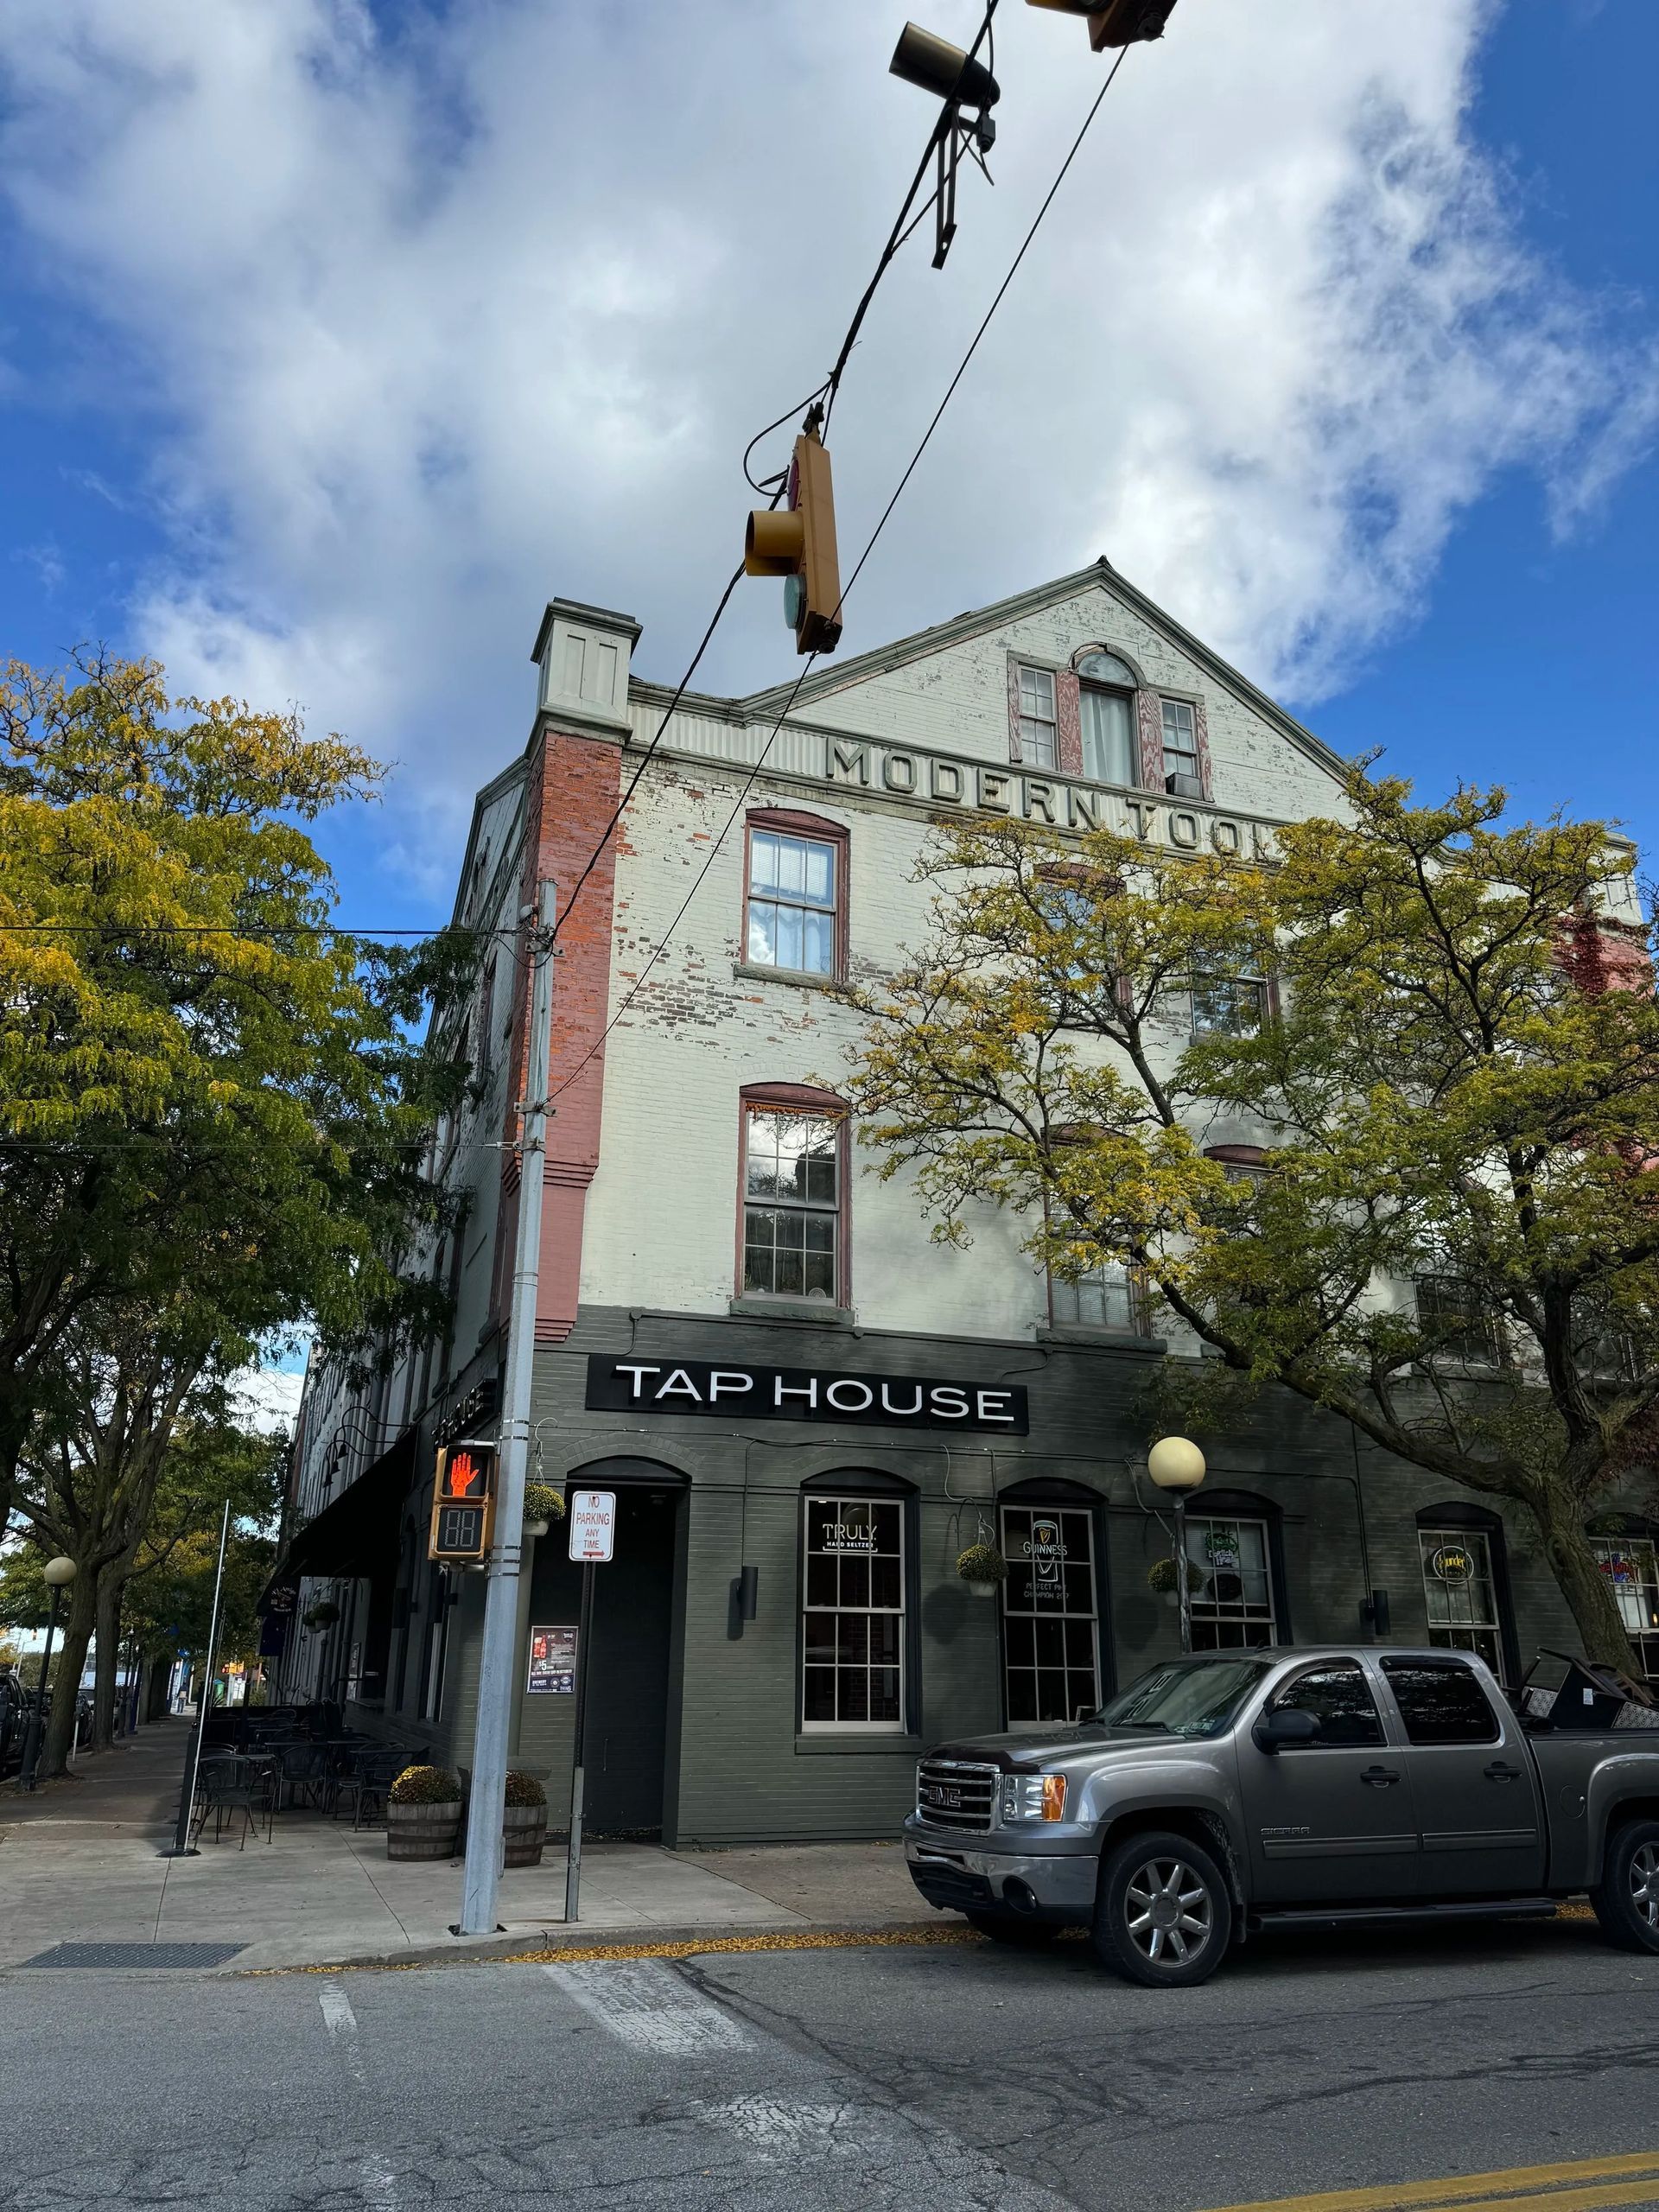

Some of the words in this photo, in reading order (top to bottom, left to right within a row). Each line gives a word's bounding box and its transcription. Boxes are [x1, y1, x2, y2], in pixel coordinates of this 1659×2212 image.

[826, 735, 1102, 831] MODERN
[1126, 798, 1286, 868] TOOL
[615, 1365, 753, 1402] TAP
[774, 1376, 1015, 1421] HOUSE
[588, 1496, 600, 1509] NO
[576, 1512, 610, 1525] PARKING
[585, 1529, 600, 1537] ANY
[583, 1540, 600, 1548] TIME
[1023, 1541, 1068, 1555] GUINNESS
[928, 1785, 961, 1808] GMC
